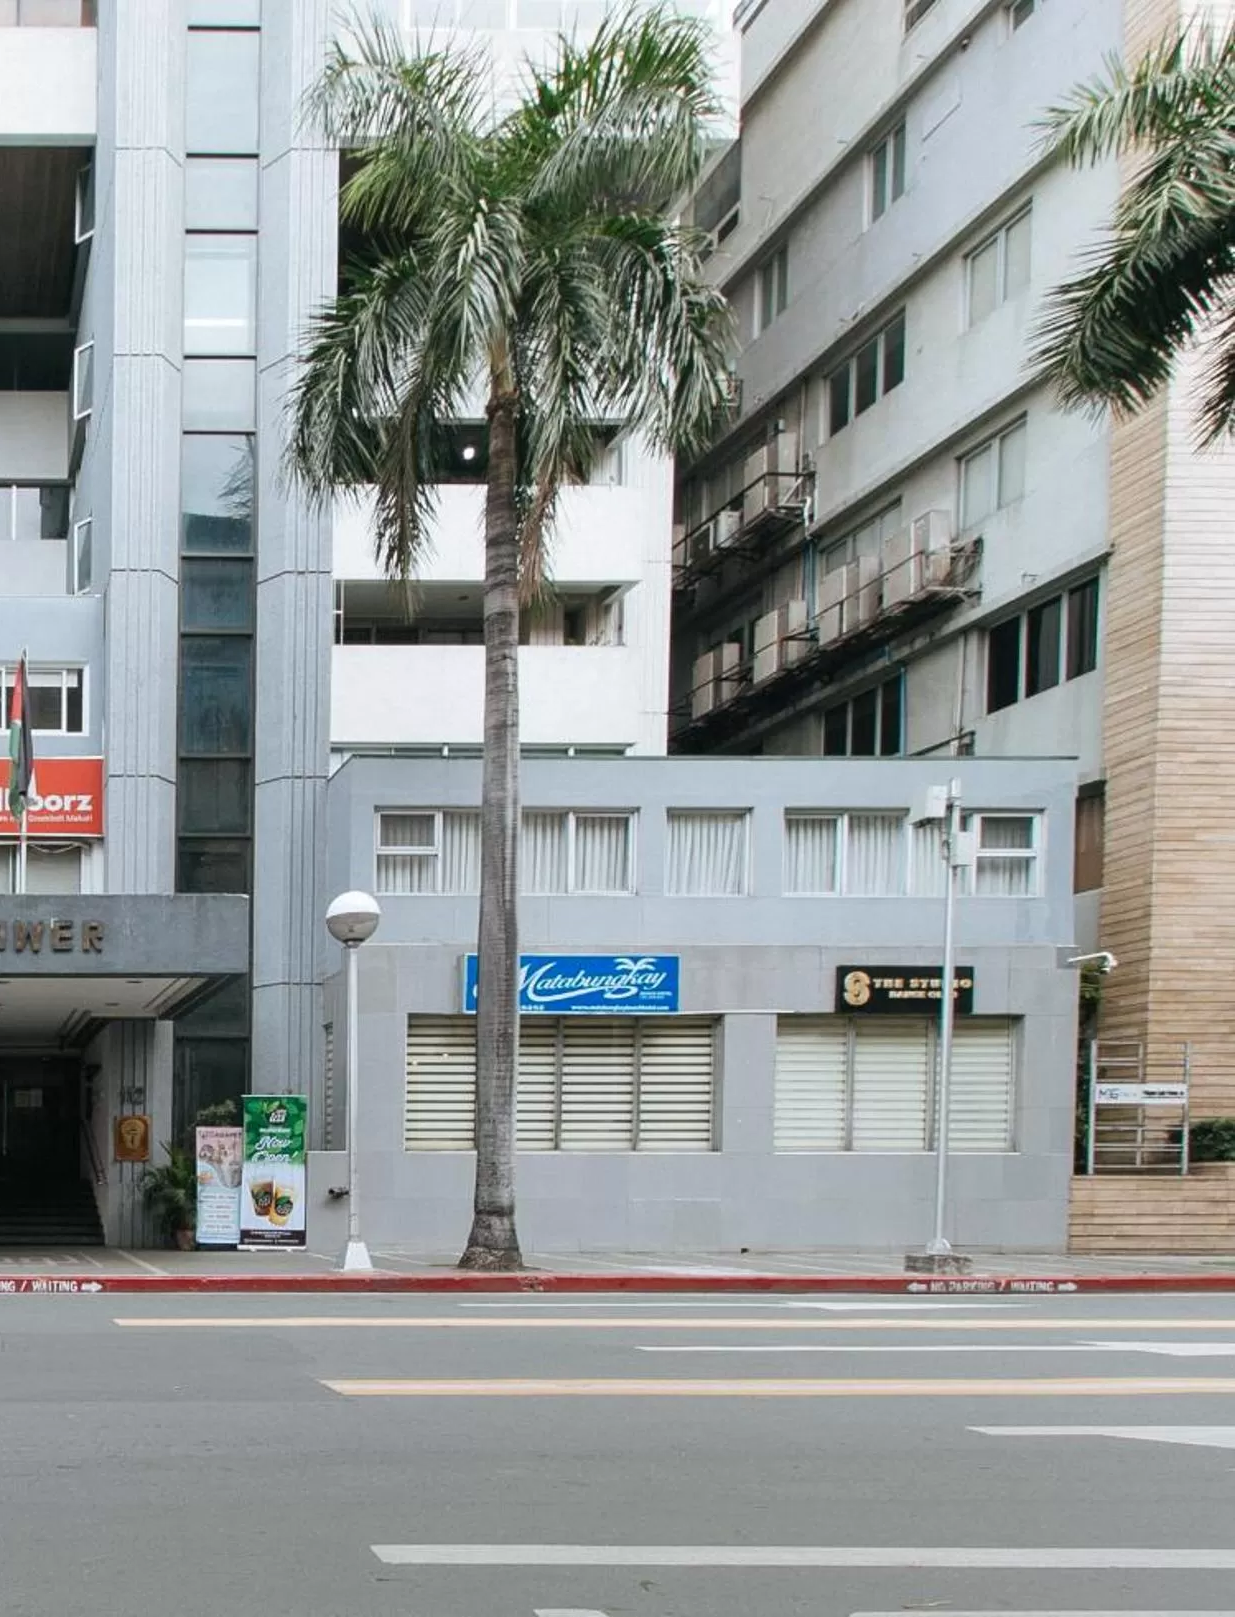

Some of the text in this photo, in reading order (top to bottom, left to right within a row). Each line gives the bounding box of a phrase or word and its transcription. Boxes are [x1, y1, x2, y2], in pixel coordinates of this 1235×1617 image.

[909, 978, 972, 989] STUIO
[32, 1281, 78, 1293] WAITING
[949, 1281, 996, 1292] PARKING
[1011, 1281, 1055, 1292] WAITING
